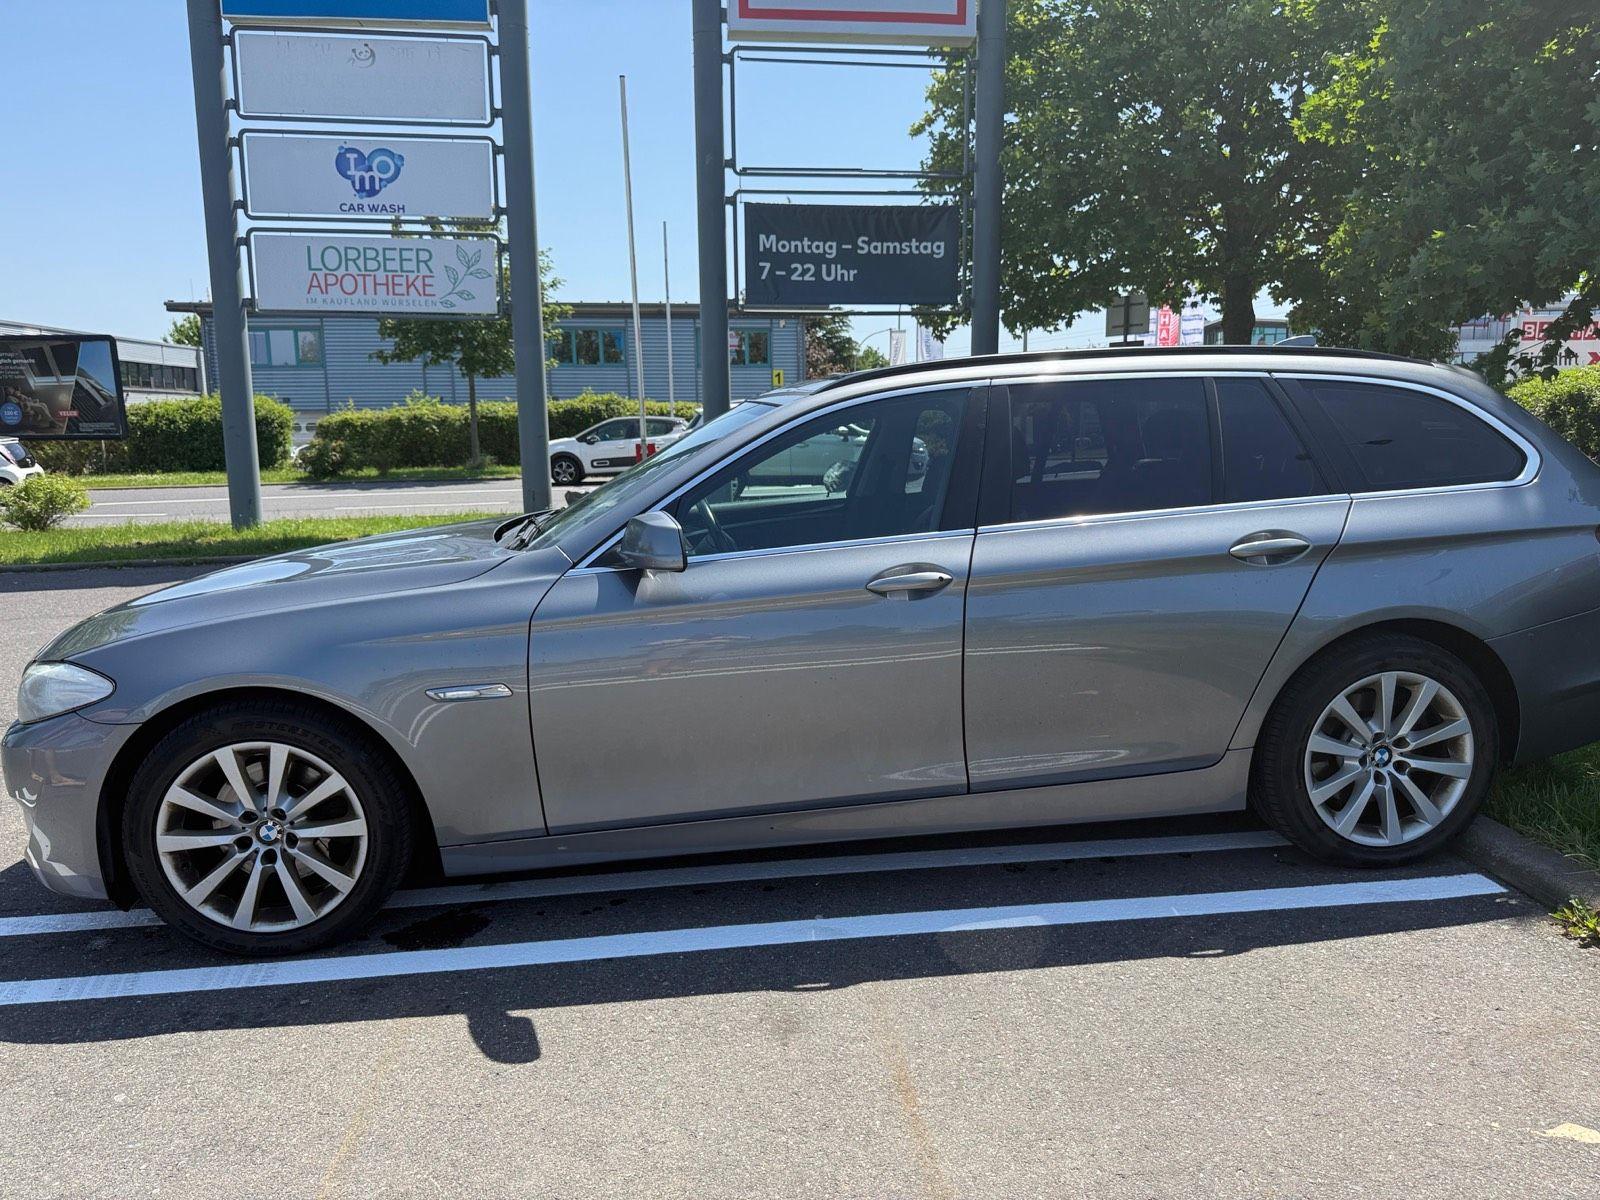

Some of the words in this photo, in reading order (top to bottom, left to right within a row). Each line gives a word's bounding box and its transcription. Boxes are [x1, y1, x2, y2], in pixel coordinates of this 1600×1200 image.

[339, 202, 365, 213] CAR
[367, 203, 406, 213] WASH
[758, 233, 837, 259] Montag
[857, 236, 945, 259] Samstag
[306, 245, 434, 274] LORBEER
[758, 262, 771, 280] 7
[790, 263, 816, 281] 22
[821, 264, 858, 282] Uhr
[306, 272, 436, 297] APOTHEKE
[305, 297, 318, 305] IM
[322, 297, 378, 306] KAUFLAND
[381, 298, 438, 308] WÜRSELEN
[774, 372, 782, 385] 1
